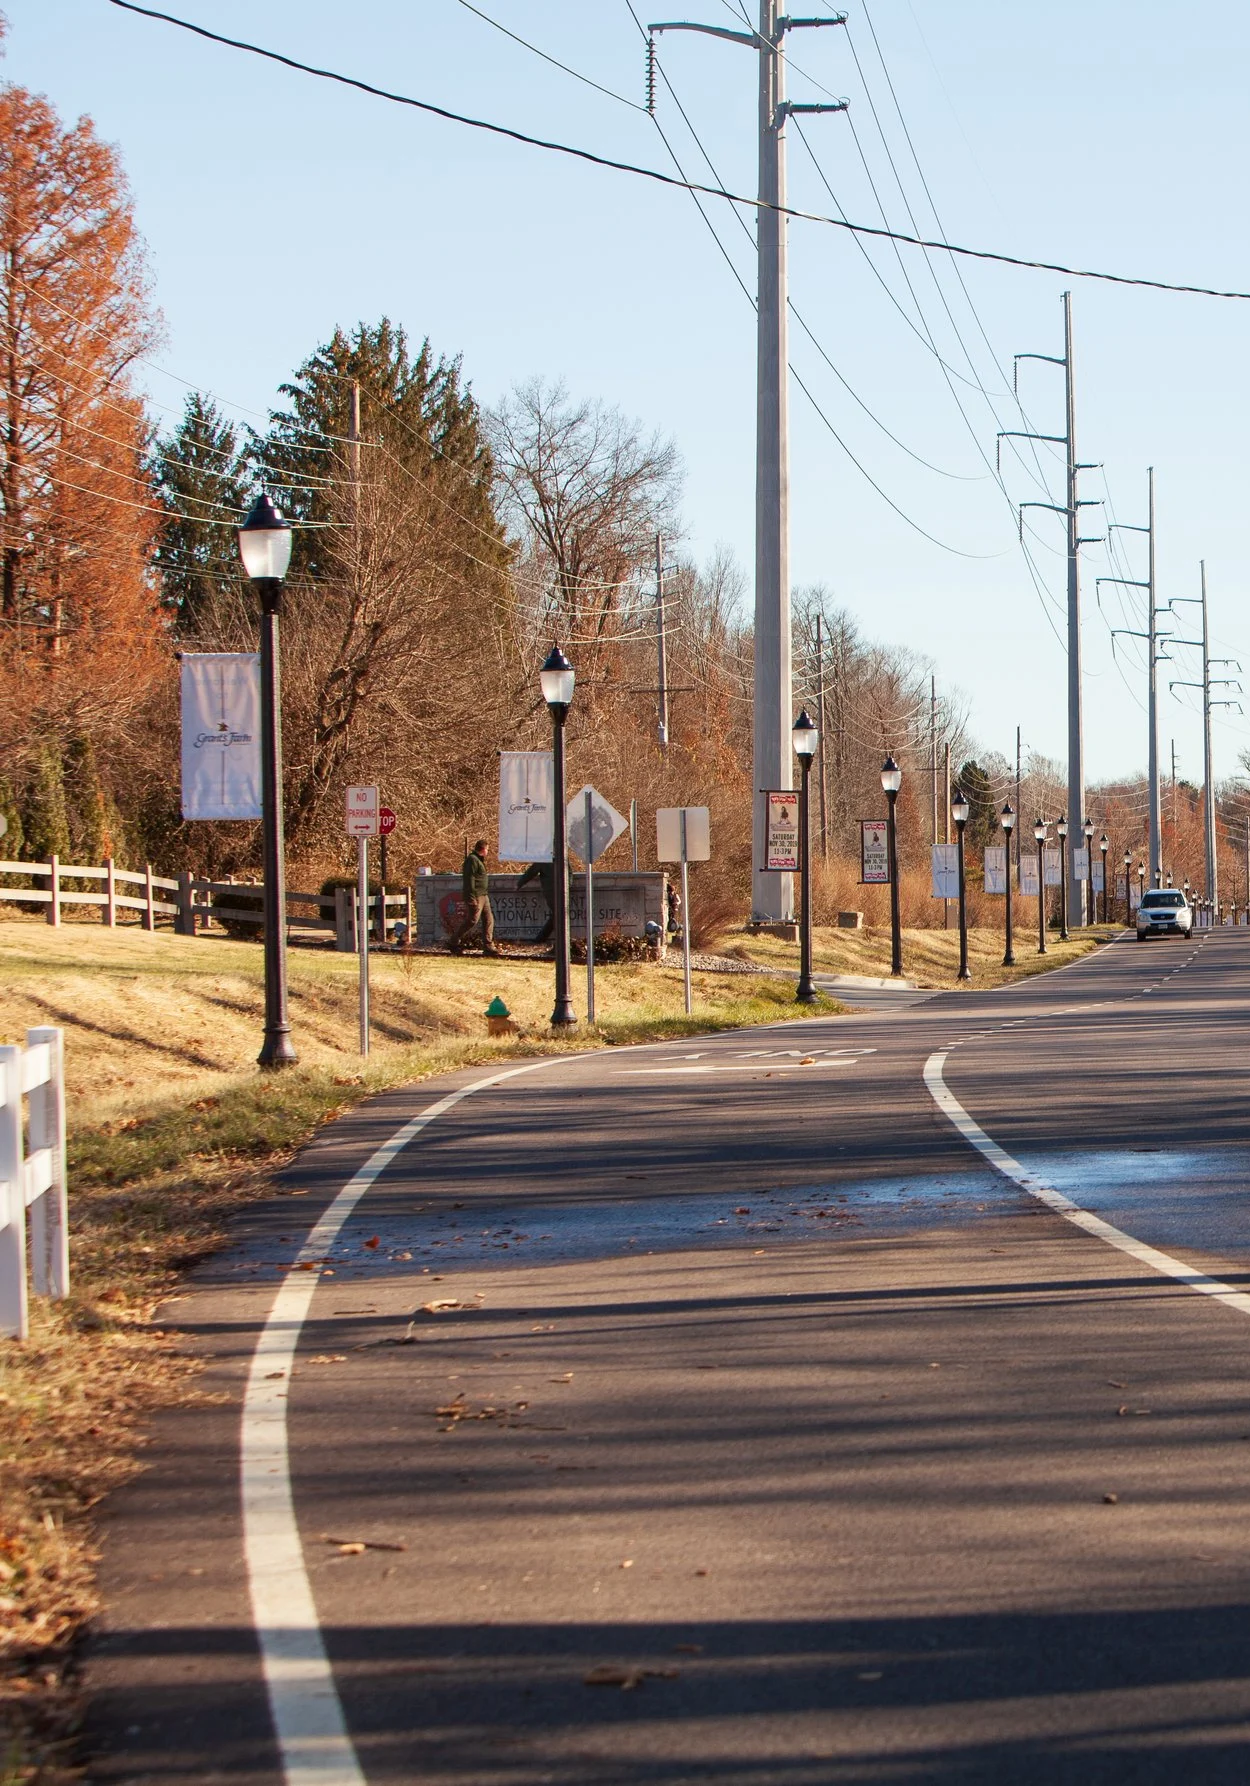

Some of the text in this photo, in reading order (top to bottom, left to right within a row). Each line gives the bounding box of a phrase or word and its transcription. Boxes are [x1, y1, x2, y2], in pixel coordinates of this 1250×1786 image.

[356, 793, 368, 803] NO
[348, 809, 376, 818] PARKING
[379, 816, 395, 827] TOP
[491, 897, 527, 909] YSSES
[492, 910, 538, 921] TIONAL
[599, 908, 622, 920] SITE
